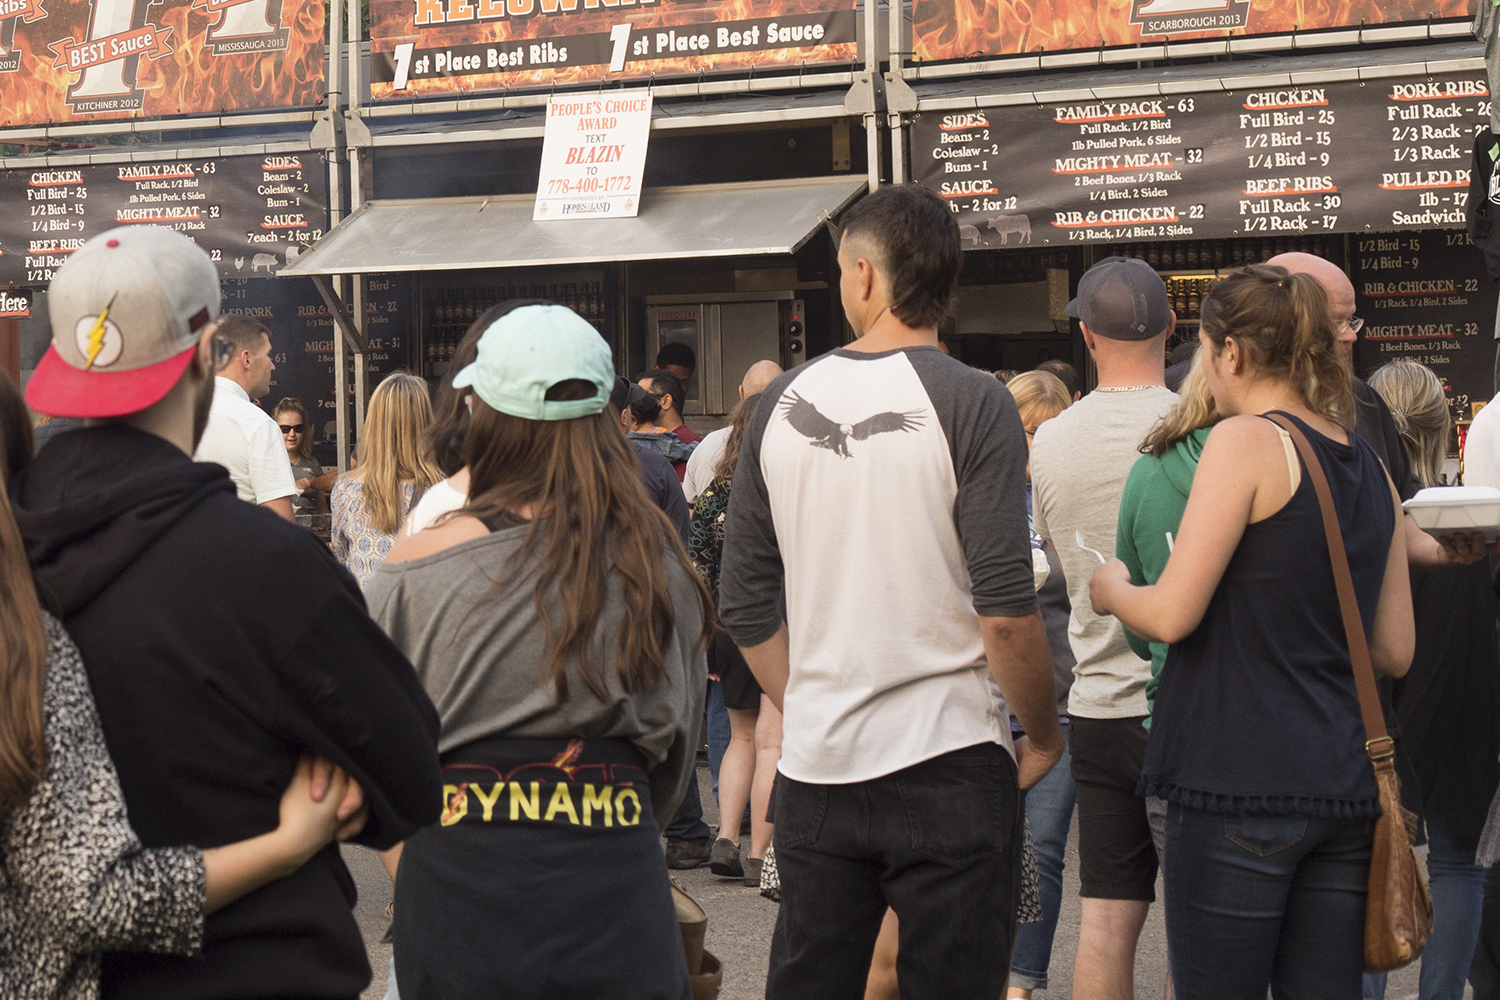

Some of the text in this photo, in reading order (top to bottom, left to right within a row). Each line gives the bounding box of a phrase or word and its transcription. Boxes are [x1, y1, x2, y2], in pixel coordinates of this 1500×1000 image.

[656, 29, 708, 54] Place
[716, 24, 759, 46] Best
[767, 21, 824, 42] Sauce
[435, 50, 481, 73] Place
[487, 47, 524, 68] Best
[530, 44, 567, 64] Ribs
[551, 99, 647, 116] PEOPLE'S CHOICE
[1246, 89, 1325, 108] CHICKEN
[1055, 101, 1164, 121] FAMILY PACK
[577, 117, 617, 131] AWARD
[943, 113, 986, 129] SIDES
[586, 134, 606, 143] TEXT
[1089, 138, 1117, 150] Pulled
[1119, 137, 1146, 149] Pork,
[1148, 136, 1154, 146] 6
[1159, 134, 1181, 146] Sides
[565, 145, 625, 165] BLAZIN
[1055, 152, 1172, 172] MIGHTY MEAT
[31, 171, 81, 185] CHICKEN
[548, 175, 631, 194] 778-400-1772
[1246, 176, 1333, 194] BEEF RIBS
[1055, 206, 1176, 226] RIB & CHICKEN
[440, 781, 643, 828] DYNAMO
